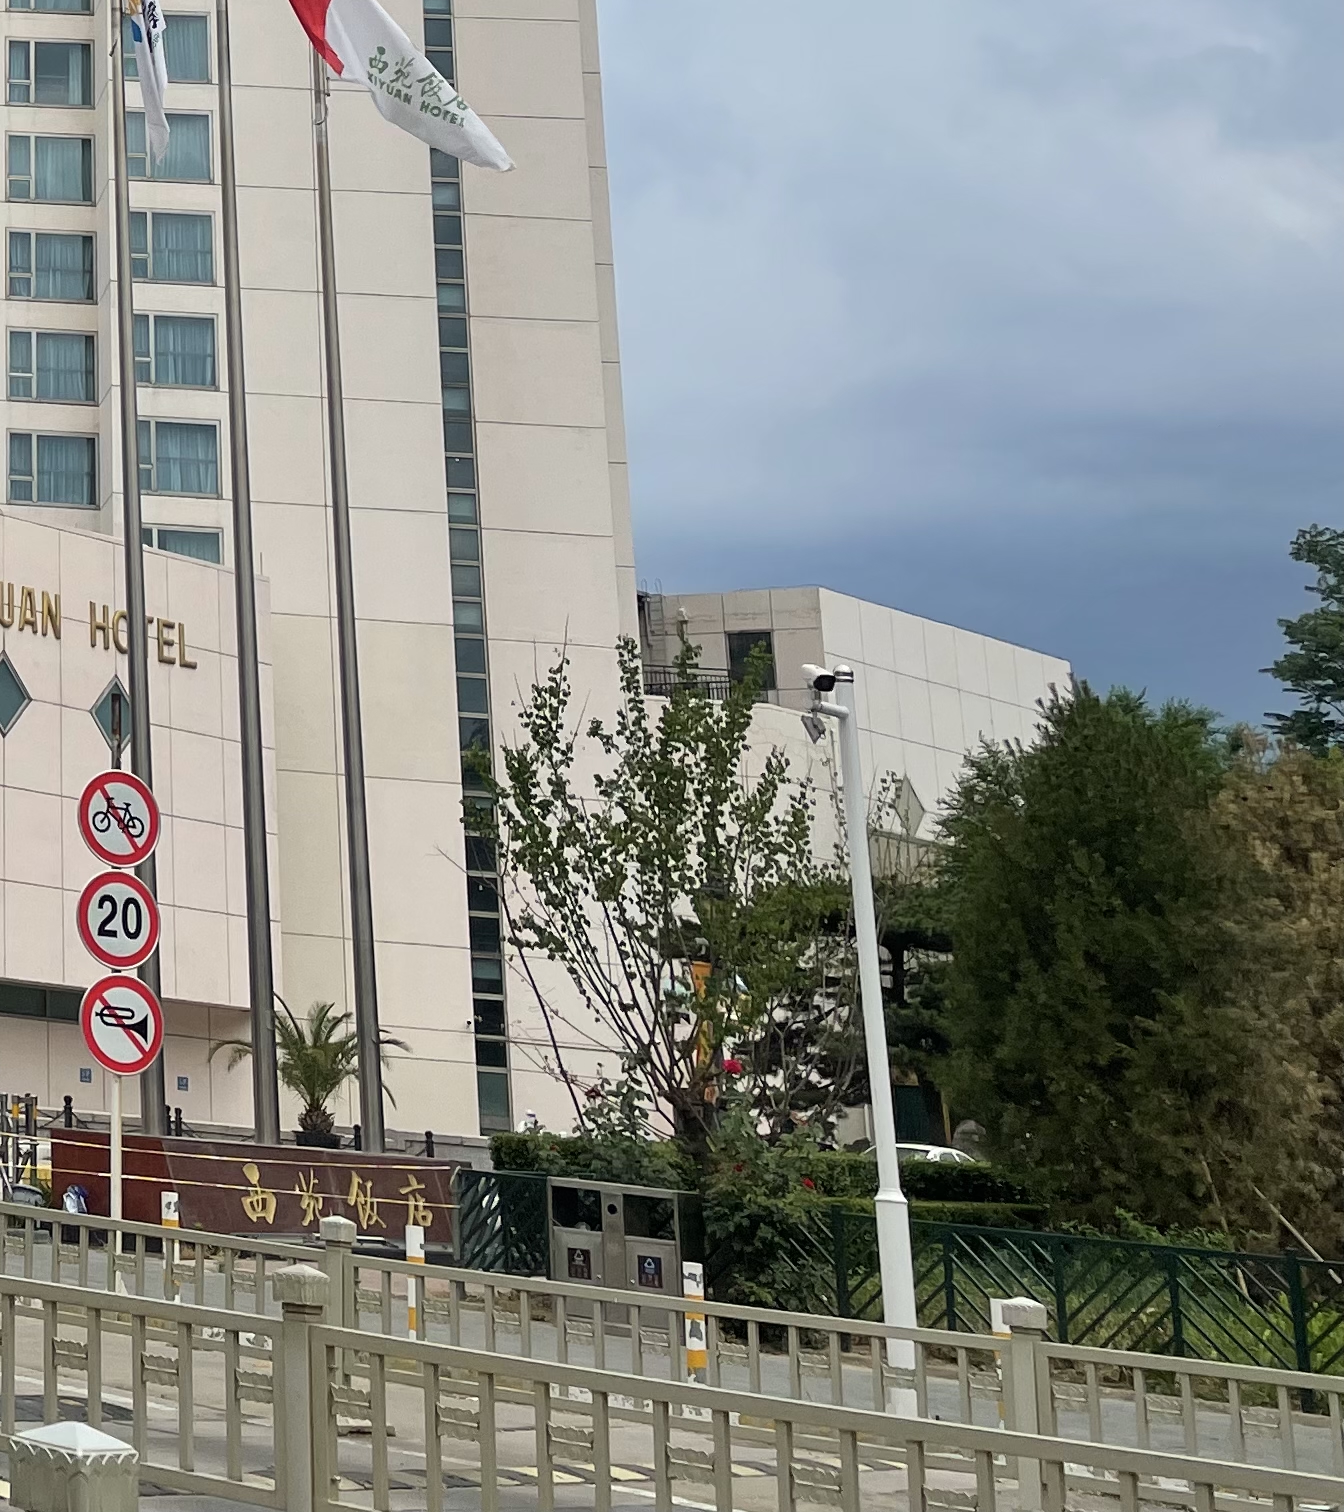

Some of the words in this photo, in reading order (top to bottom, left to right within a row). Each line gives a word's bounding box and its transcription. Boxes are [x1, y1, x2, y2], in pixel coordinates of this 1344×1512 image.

[367, 70, 413, 105] XIYUAN
[419, 100, 466, 128] HOTEL
[97, 893, 143, 942] 20
[240, 1162, 434, 1230] 西苑饭店
